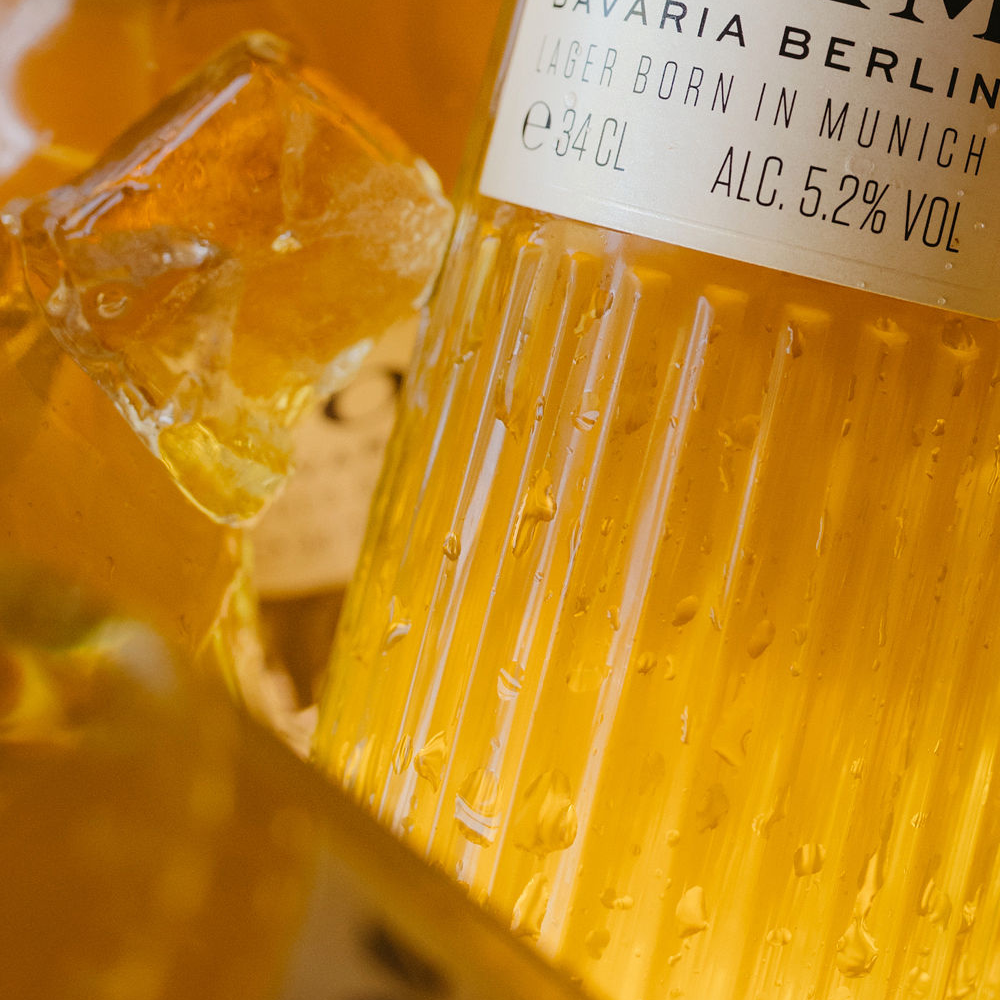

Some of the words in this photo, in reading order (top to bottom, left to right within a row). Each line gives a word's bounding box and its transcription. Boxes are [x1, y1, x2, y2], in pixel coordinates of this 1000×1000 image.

[535, 35, 618, 88] LAGER
[632, 54, 735, 114] BORN
[754, 82, 798, 129] IN
[818, 97, 987, 177] MUNICH
[710, 145, 784, 211] ALC.
[799, 165, 890, 234] 5.2%
[903, 189, 961, 254] VOL
